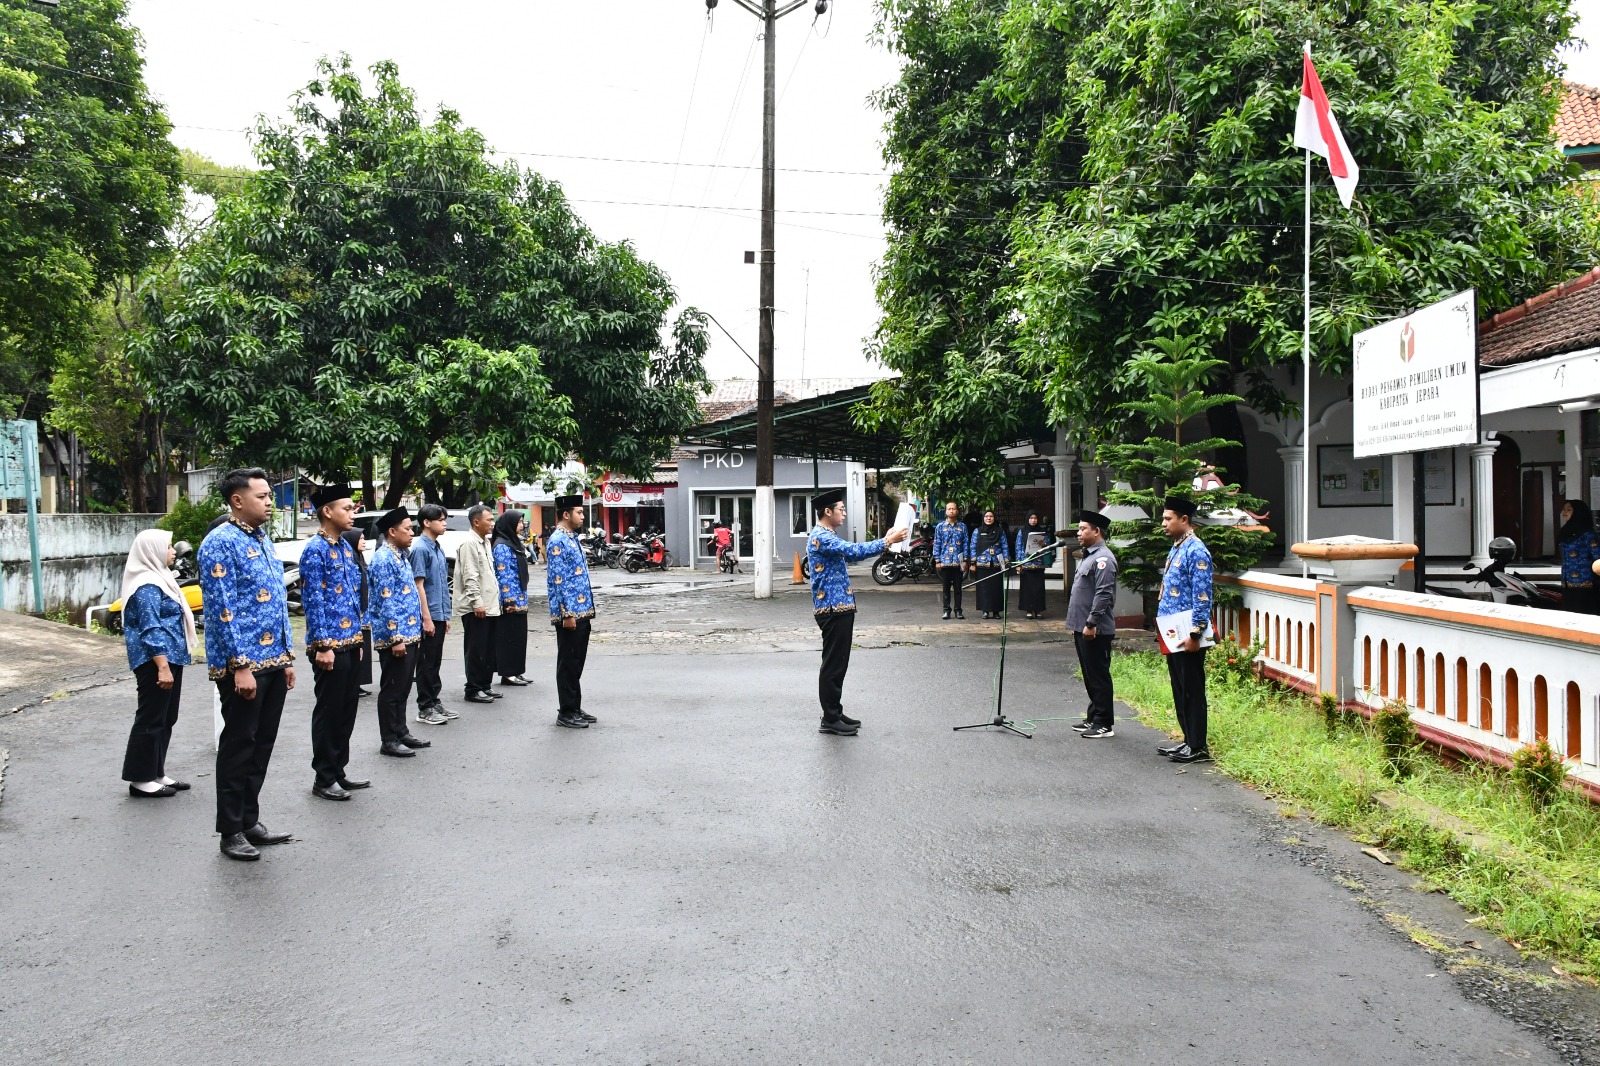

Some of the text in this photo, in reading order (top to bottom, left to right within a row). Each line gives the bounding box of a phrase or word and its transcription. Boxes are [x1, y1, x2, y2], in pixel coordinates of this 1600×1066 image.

[1361, 361, 1467, 399] BADAN PENGAWAS PEMILIHAN UMUM
[1380, 386, 1440, 410] KABUPATEN JEPARA
[703, 453, 744, 469] PKD
